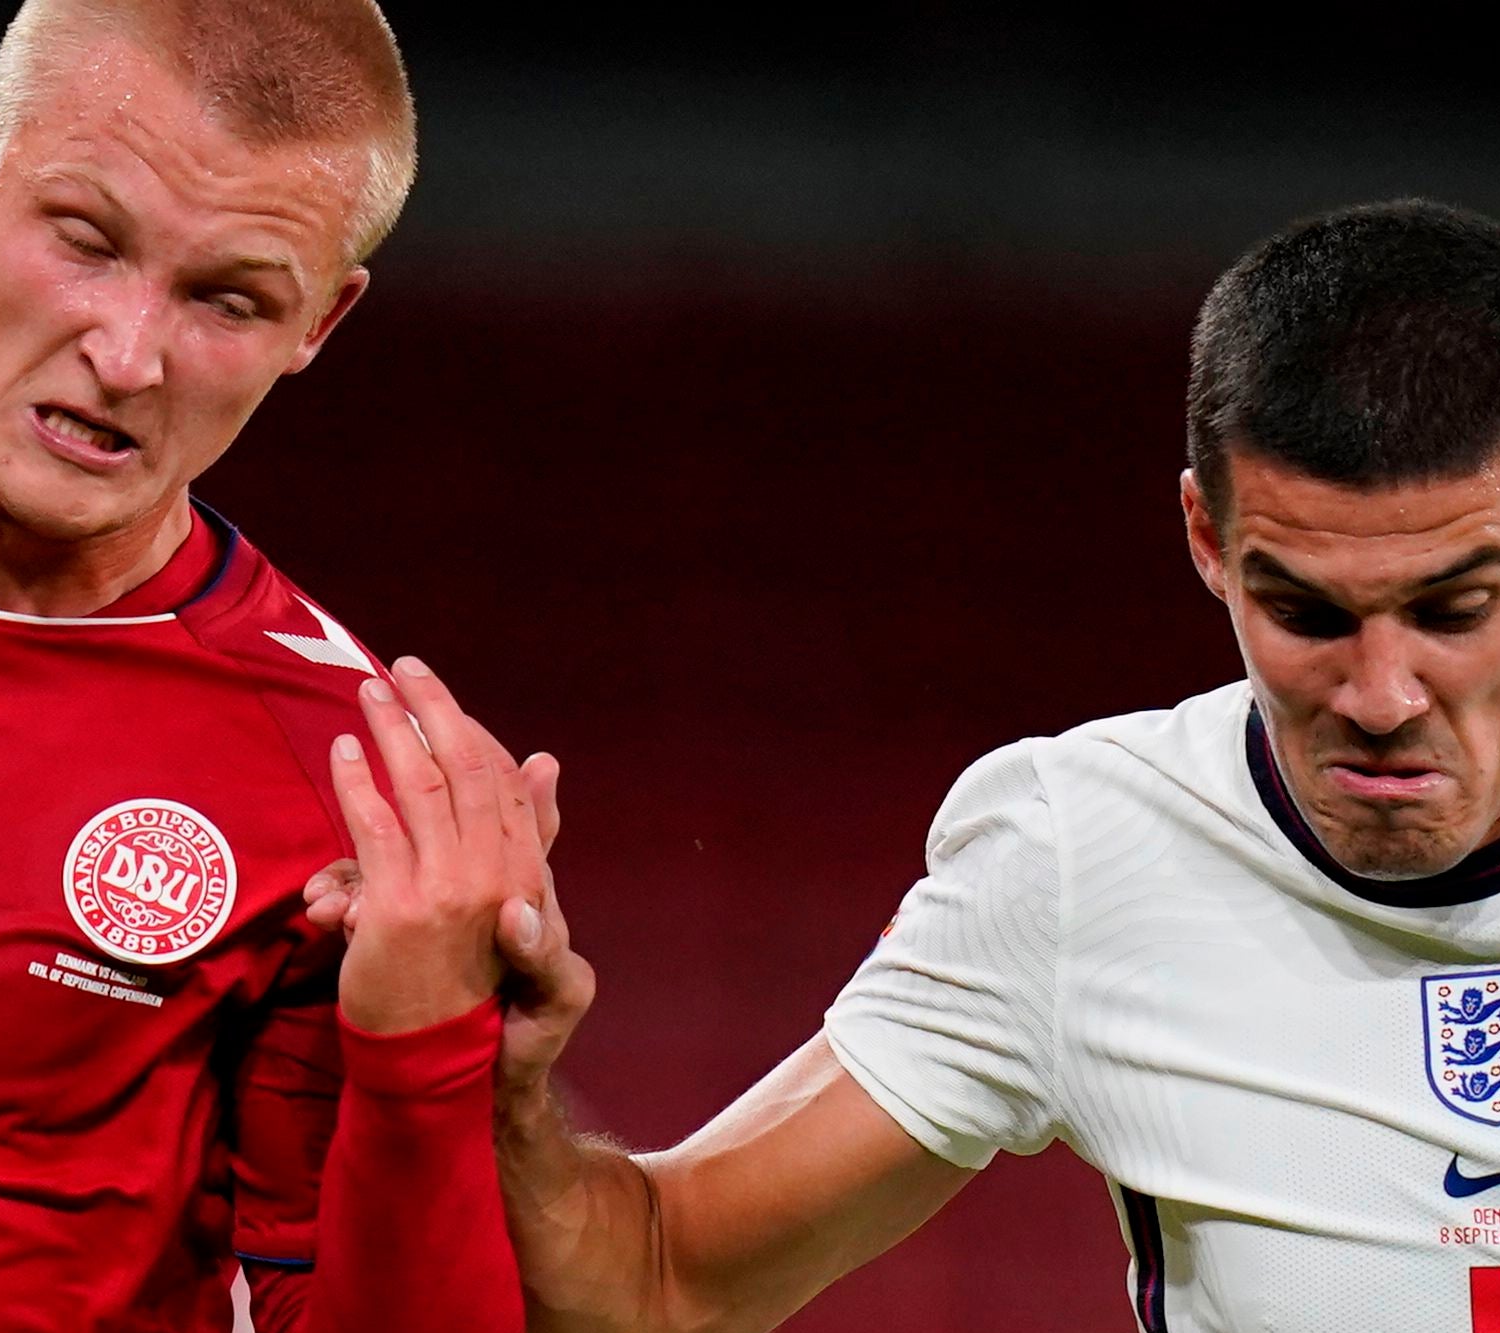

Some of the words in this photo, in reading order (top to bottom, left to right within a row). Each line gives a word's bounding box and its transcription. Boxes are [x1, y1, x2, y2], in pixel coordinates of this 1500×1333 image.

[75, 823, 117, 912] DANSK
[101, 843, 201, 914] DBU
[95, 917, 158, 954] 1889
[49, 968, 63, 982] OF
[1440, 1226, 1450, 1244] 8
